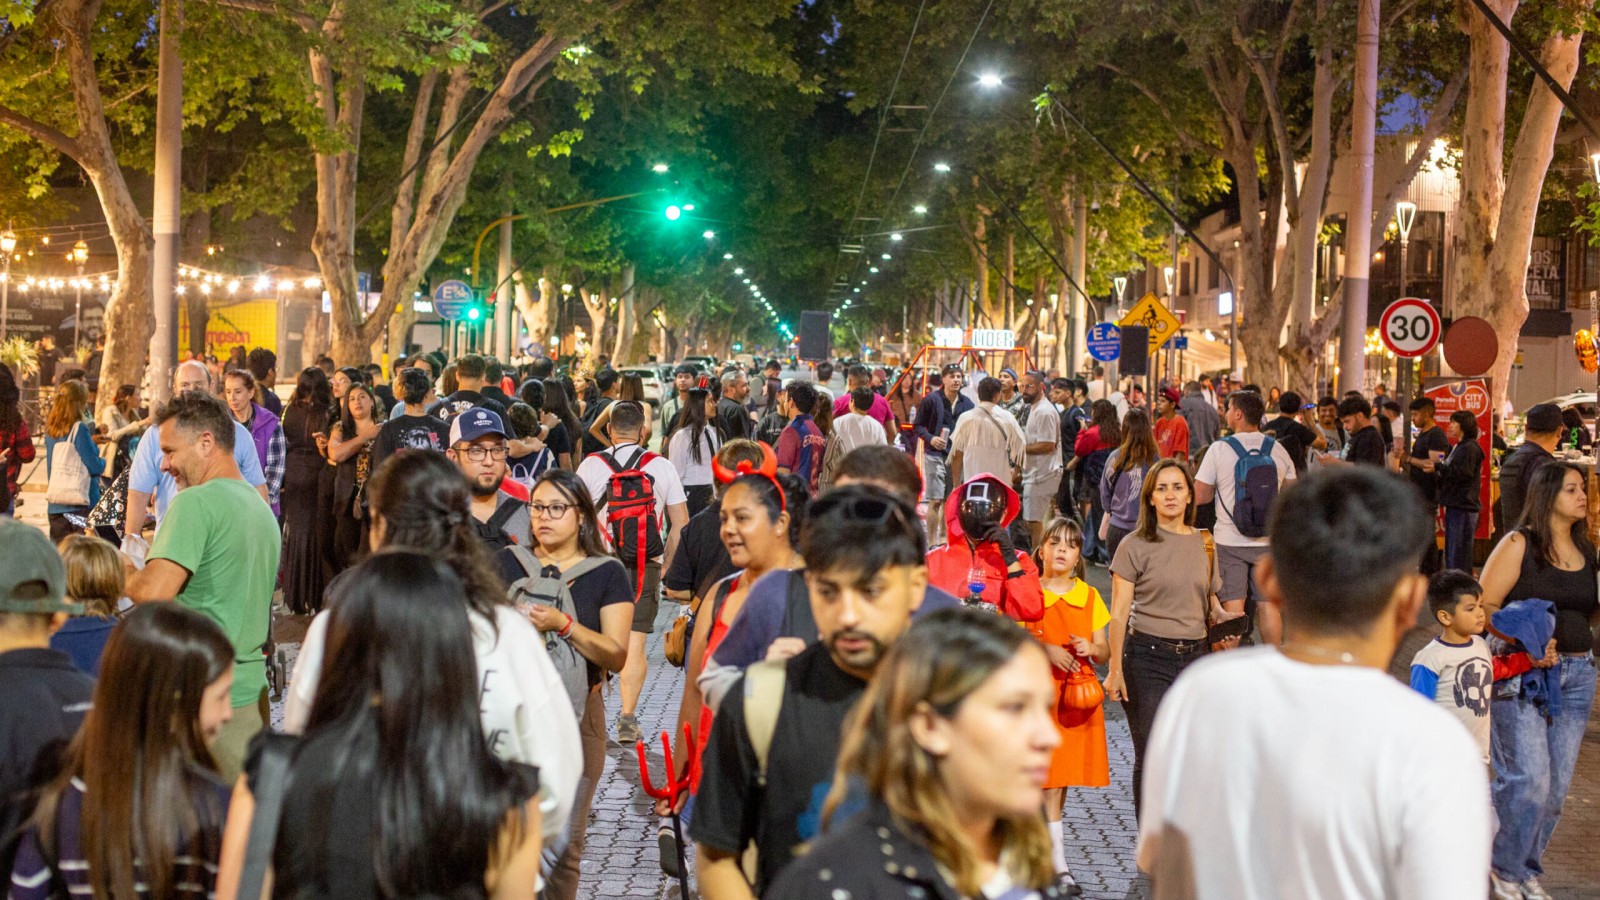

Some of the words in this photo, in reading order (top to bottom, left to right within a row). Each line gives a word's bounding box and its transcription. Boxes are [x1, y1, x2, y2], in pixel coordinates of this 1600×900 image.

[1531, 250, 1551, 265] OS
[442, 286, 453, 299] E
[1093, 327, 1103, 341] E
[1391, 315, 1430, 341] 30
[205, 331, 250, 347] mpson
[1464, 393, 1483, 401] CITY
[1465, 401, 1481, 409] BUS
